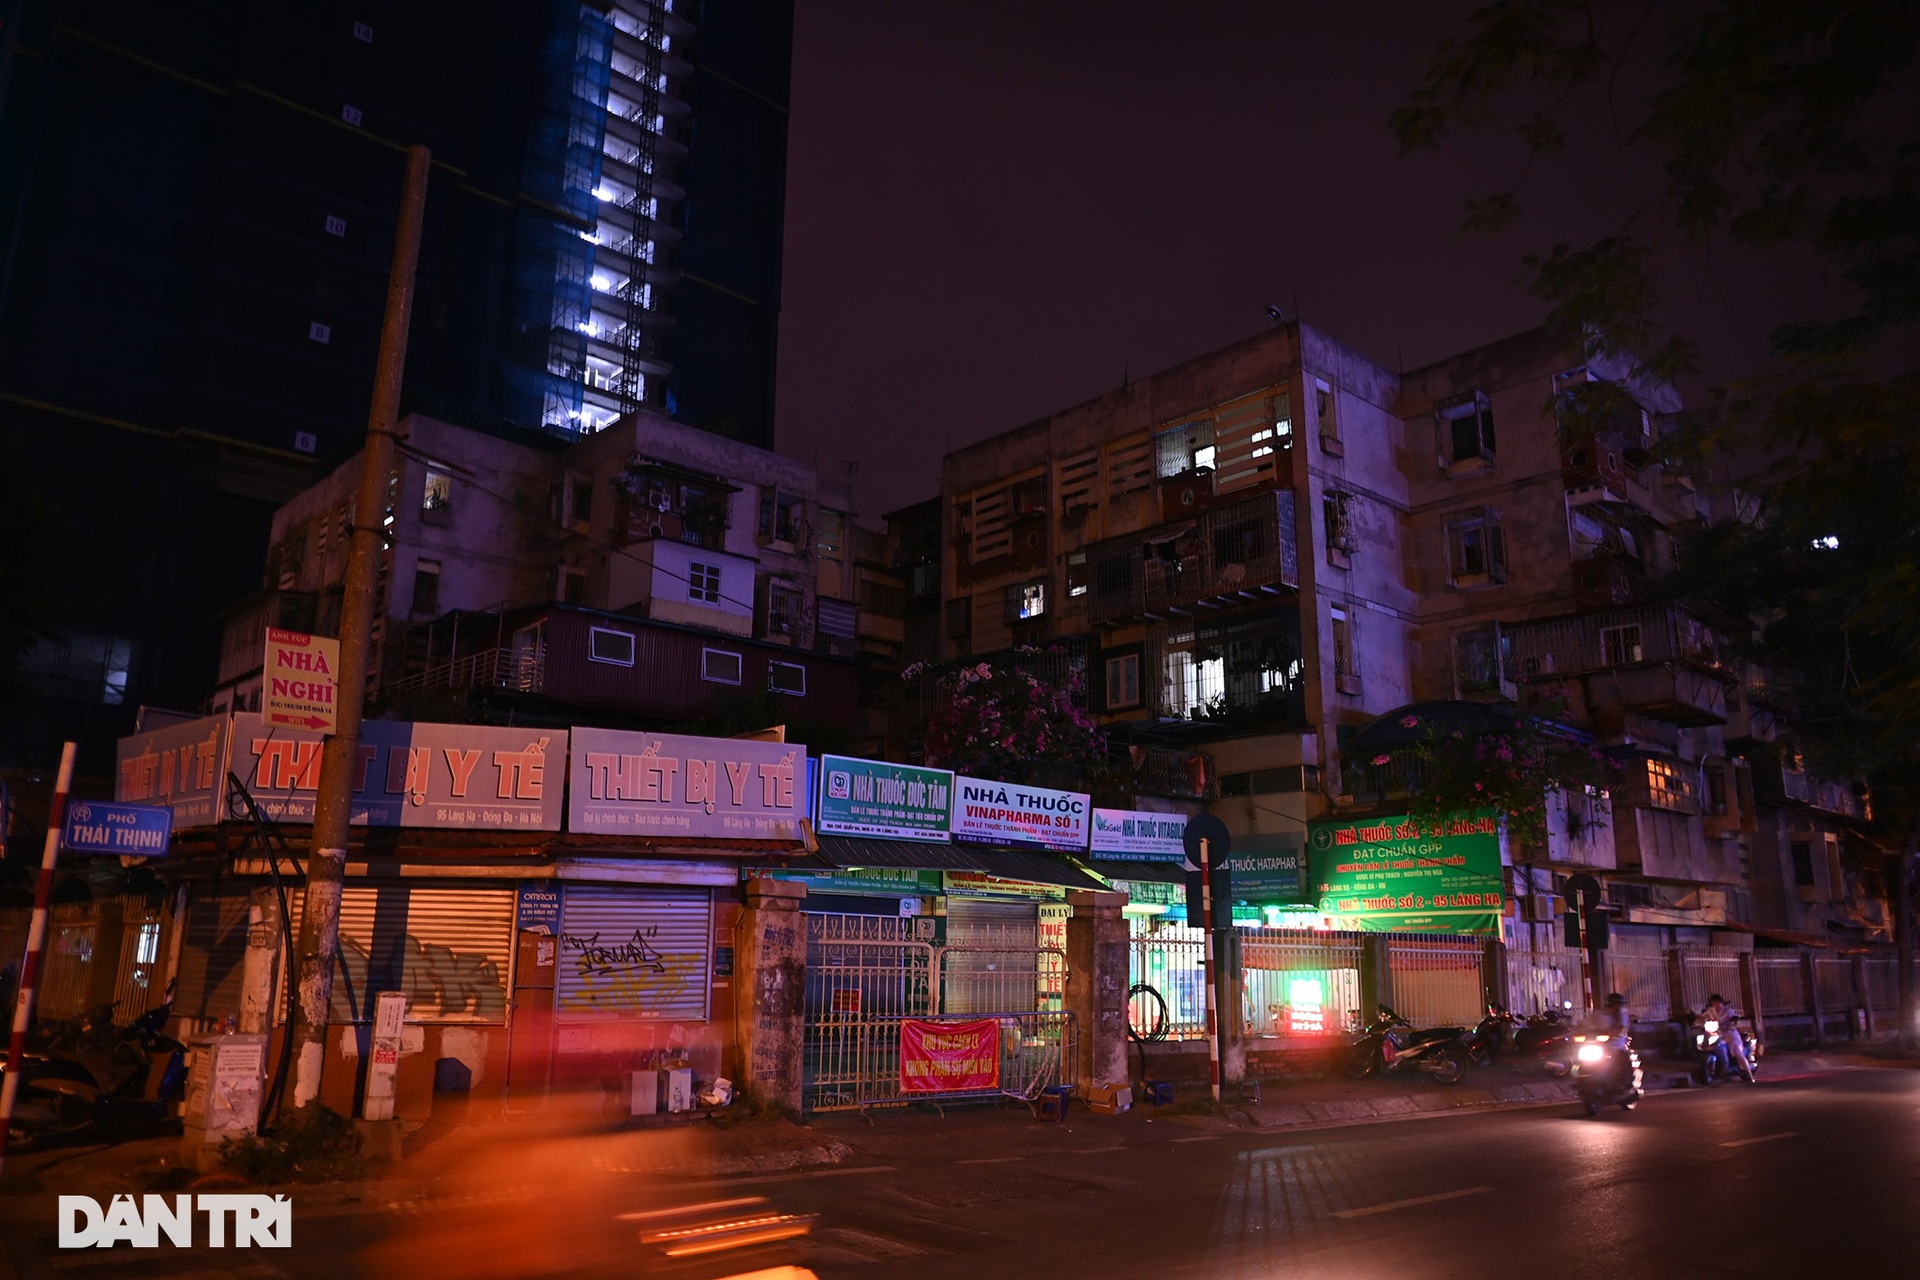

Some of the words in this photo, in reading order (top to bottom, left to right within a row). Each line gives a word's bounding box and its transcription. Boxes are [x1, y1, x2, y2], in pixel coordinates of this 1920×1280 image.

[346, 109, 360, 125] 12
[330, 220, 343, 234] 10
[316, 327, 324, 339] 8
[301, 436, 309, 448] 6
[277, 649, 330, 674] NHÀ
[271, 677, 333, 704] NGHỈ
[288, 716, 305, 725] WIFI
[179, 744, 194, 793] Y
[195, 723, 220, 791] TẾ
[384, 746, 431, 807] BỊ
[443, 748, 482, 798] Y
[493, 737, 550, 800] TẾ
[586, 741, 678, 802] THIẾT
[685, 758, 716, 815] BỊ
[724, 761, 751, 805] Y
[758, 751, 796, 808] TẾ
[852, 770, 874, 802] NHÀ
[875, 770, 906, 806] THUỐC
[907, 775, 926, 809] ĐỨC
[927, 779, 947, 810] TÂM
[963, 786, 1009, 805] NHÀ
[1016, 794, 1083, 814] THUỐC
[107, 812, 138, 824] PHỐ
[966, 805, 1051, 826] VINAPHARMA
[1054, 813, 1071, 829] SỐ
[1075, 819, 1080, 830] 1
[1122, 816, 1135, 837] NHÀ
[1137, 815, 1156, 838] THUỐC
[73, 824, 110, 844] THÁI
[115, 828, 162, 850] THỊNH
[1335, 825, 1358, 845] NHÀ
[1358, 821, 1393, 843] THUỐC
[1395, 819, 1410, 840] SỐ
[1231, 854, 1256, 872] THUỐC
[1257, 856, 1297, 871] HATAPHAR
[1353, 848, 1375, 861] ĐẠT
[1377, 842, 1416, 858] CHUẨN
[1419, 843, 1442, 855] GPP
[524, 893, 556, 901] OMRON
[1338, 896, 1361, 911] NHÀ
[1362, 894, 1397, 910] THUỐC
[1398, 891, 1414, 909] SỐ
[1416, 896, 1425, 908] 2
[1433, 896, 1448, 908] 95
[1450, 890, 1480, 907] LÁNG
[1483, 893, 1501, 909] HẠ
